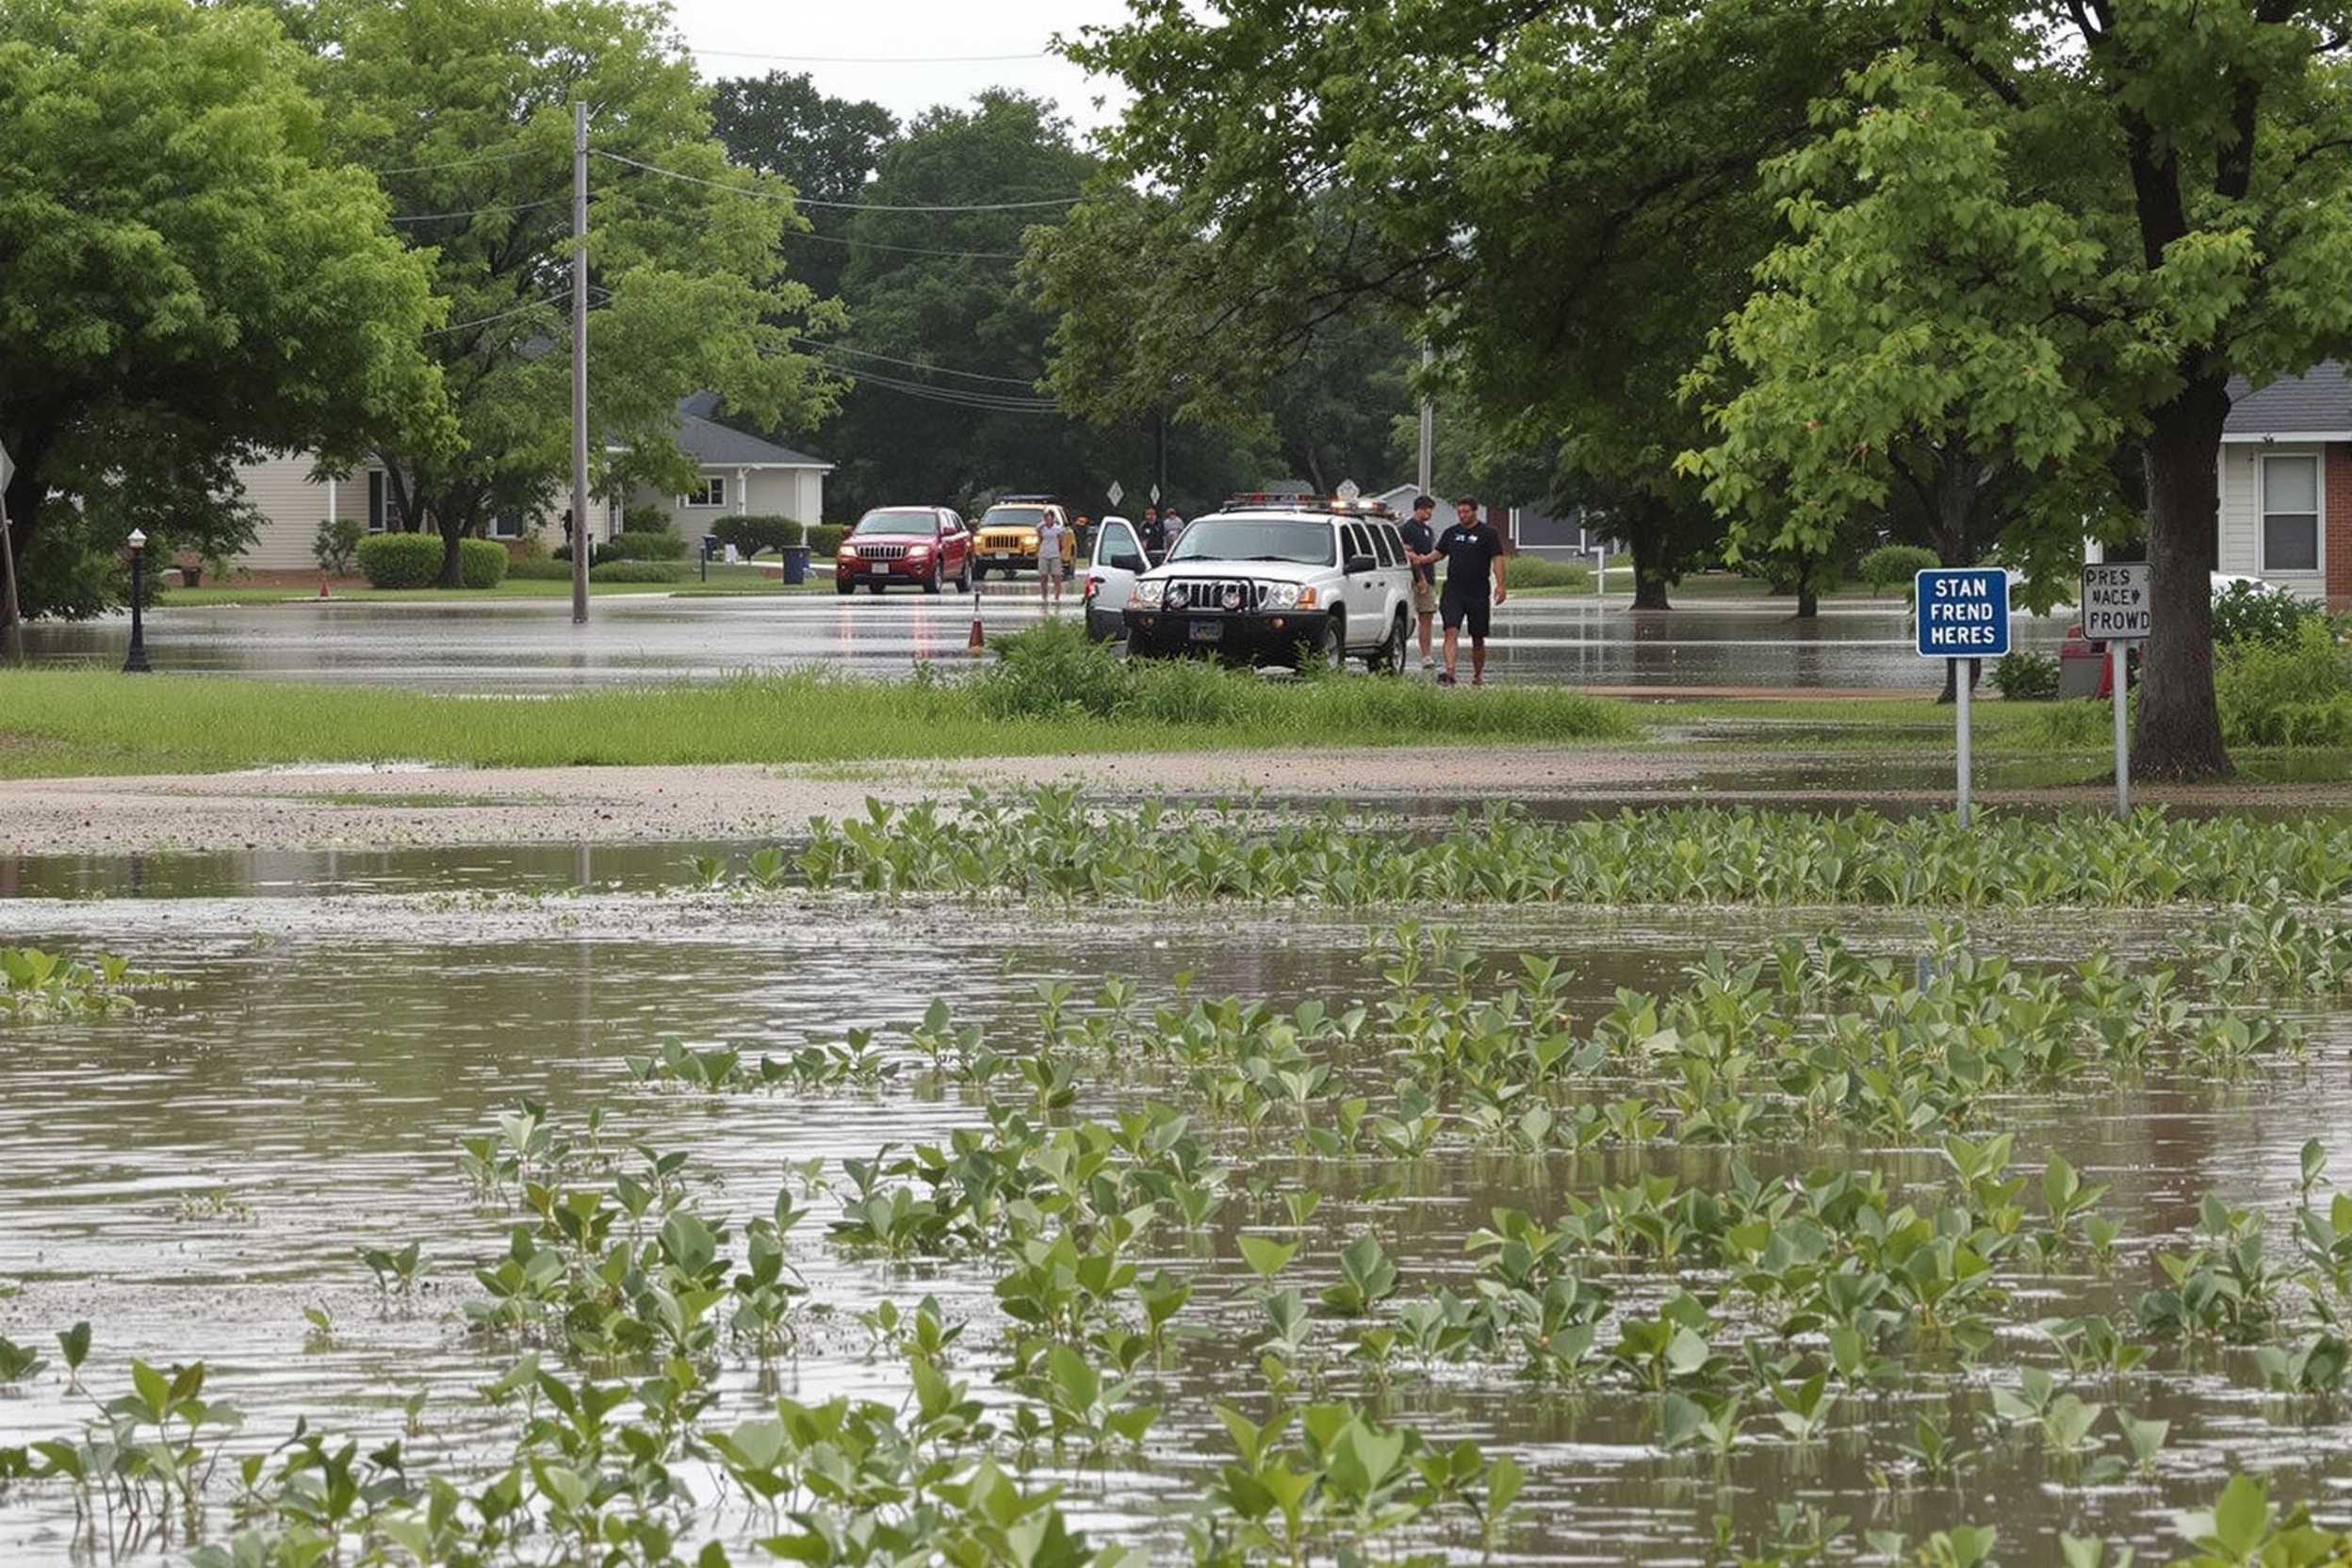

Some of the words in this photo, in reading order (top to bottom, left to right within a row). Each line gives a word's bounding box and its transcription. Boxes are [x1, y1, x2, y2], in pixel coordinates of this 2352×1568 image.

[2085, 568, 2131, 586] PRES
[1935, 578, 1986, 597] STAN
[1930, 603, 1994, 621] FREND
[2090, 612, 2149, 629] PROWD
[1931, 626, 1995, 645] HERES
